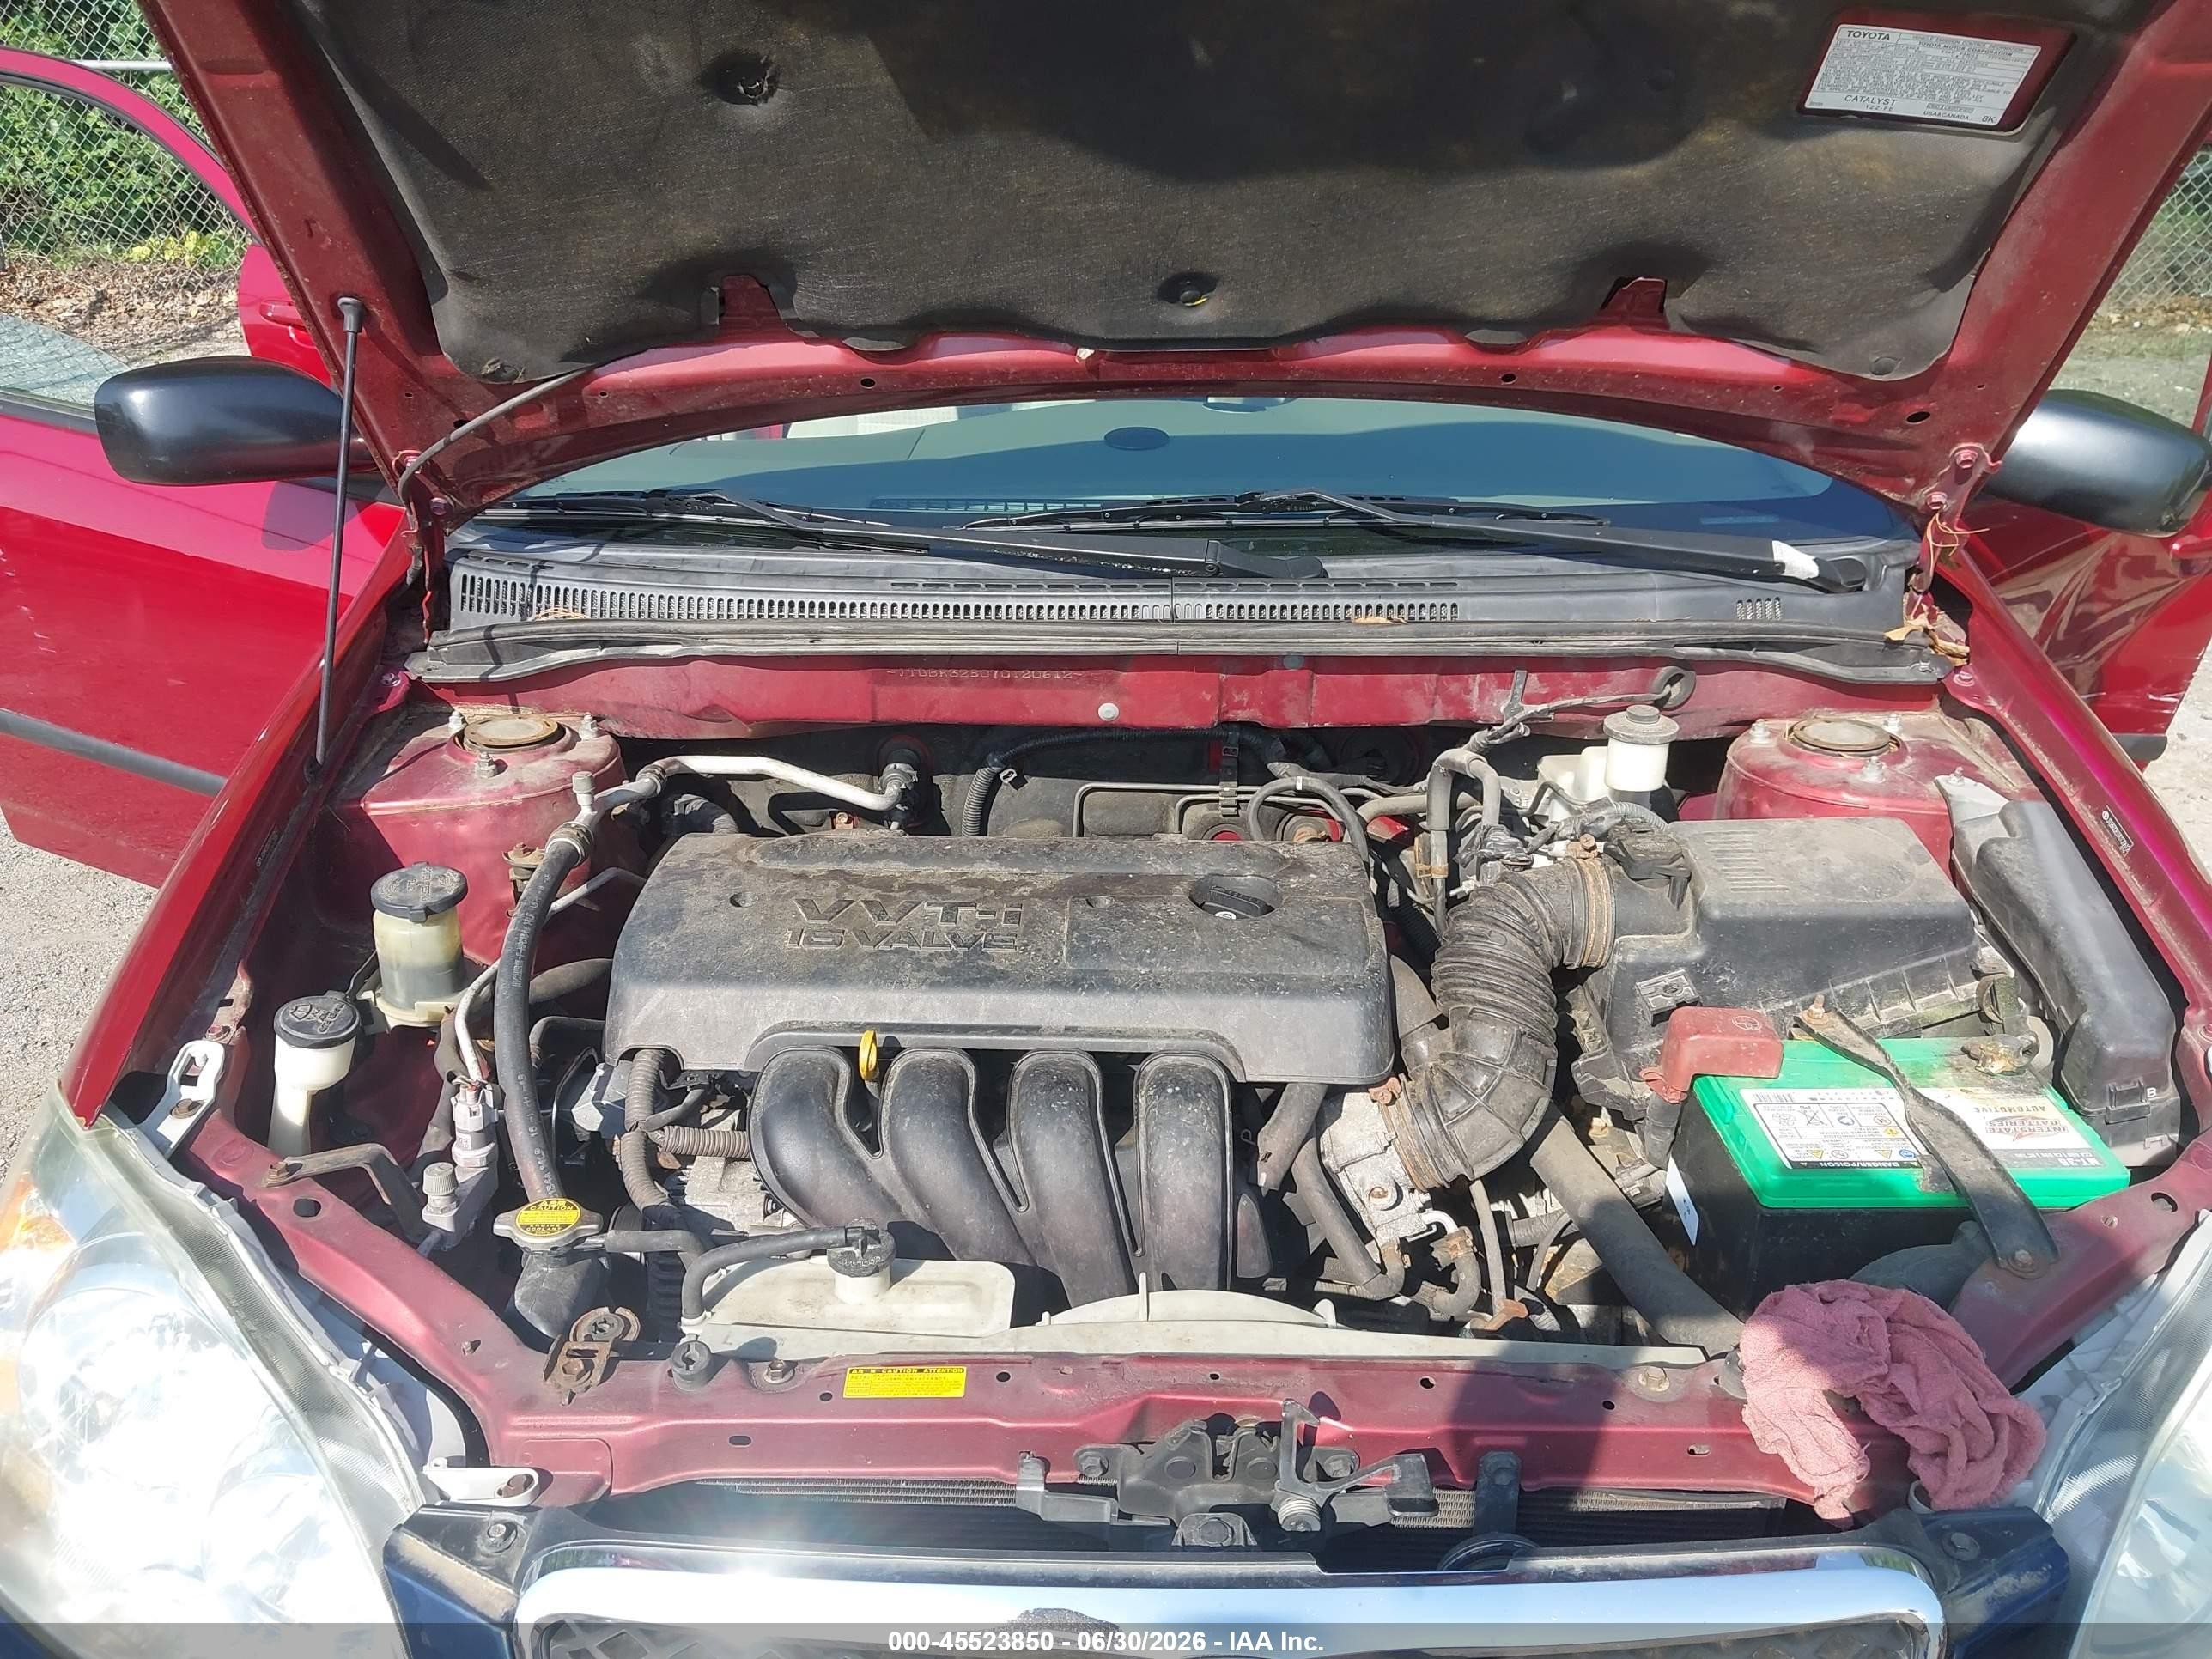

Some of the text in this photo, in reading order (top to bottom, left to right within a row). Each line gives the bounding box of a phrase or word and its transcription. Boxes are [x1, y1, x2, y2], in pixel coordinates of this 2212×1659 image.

[1847, 30, 1890, 40] TOYOTA
[1844, 94, 1898, 106] CATALYST
[2146, 1087, 2157, 1098] B
[1973, 1105, 2045, 1114] AUTOMOTIVE
